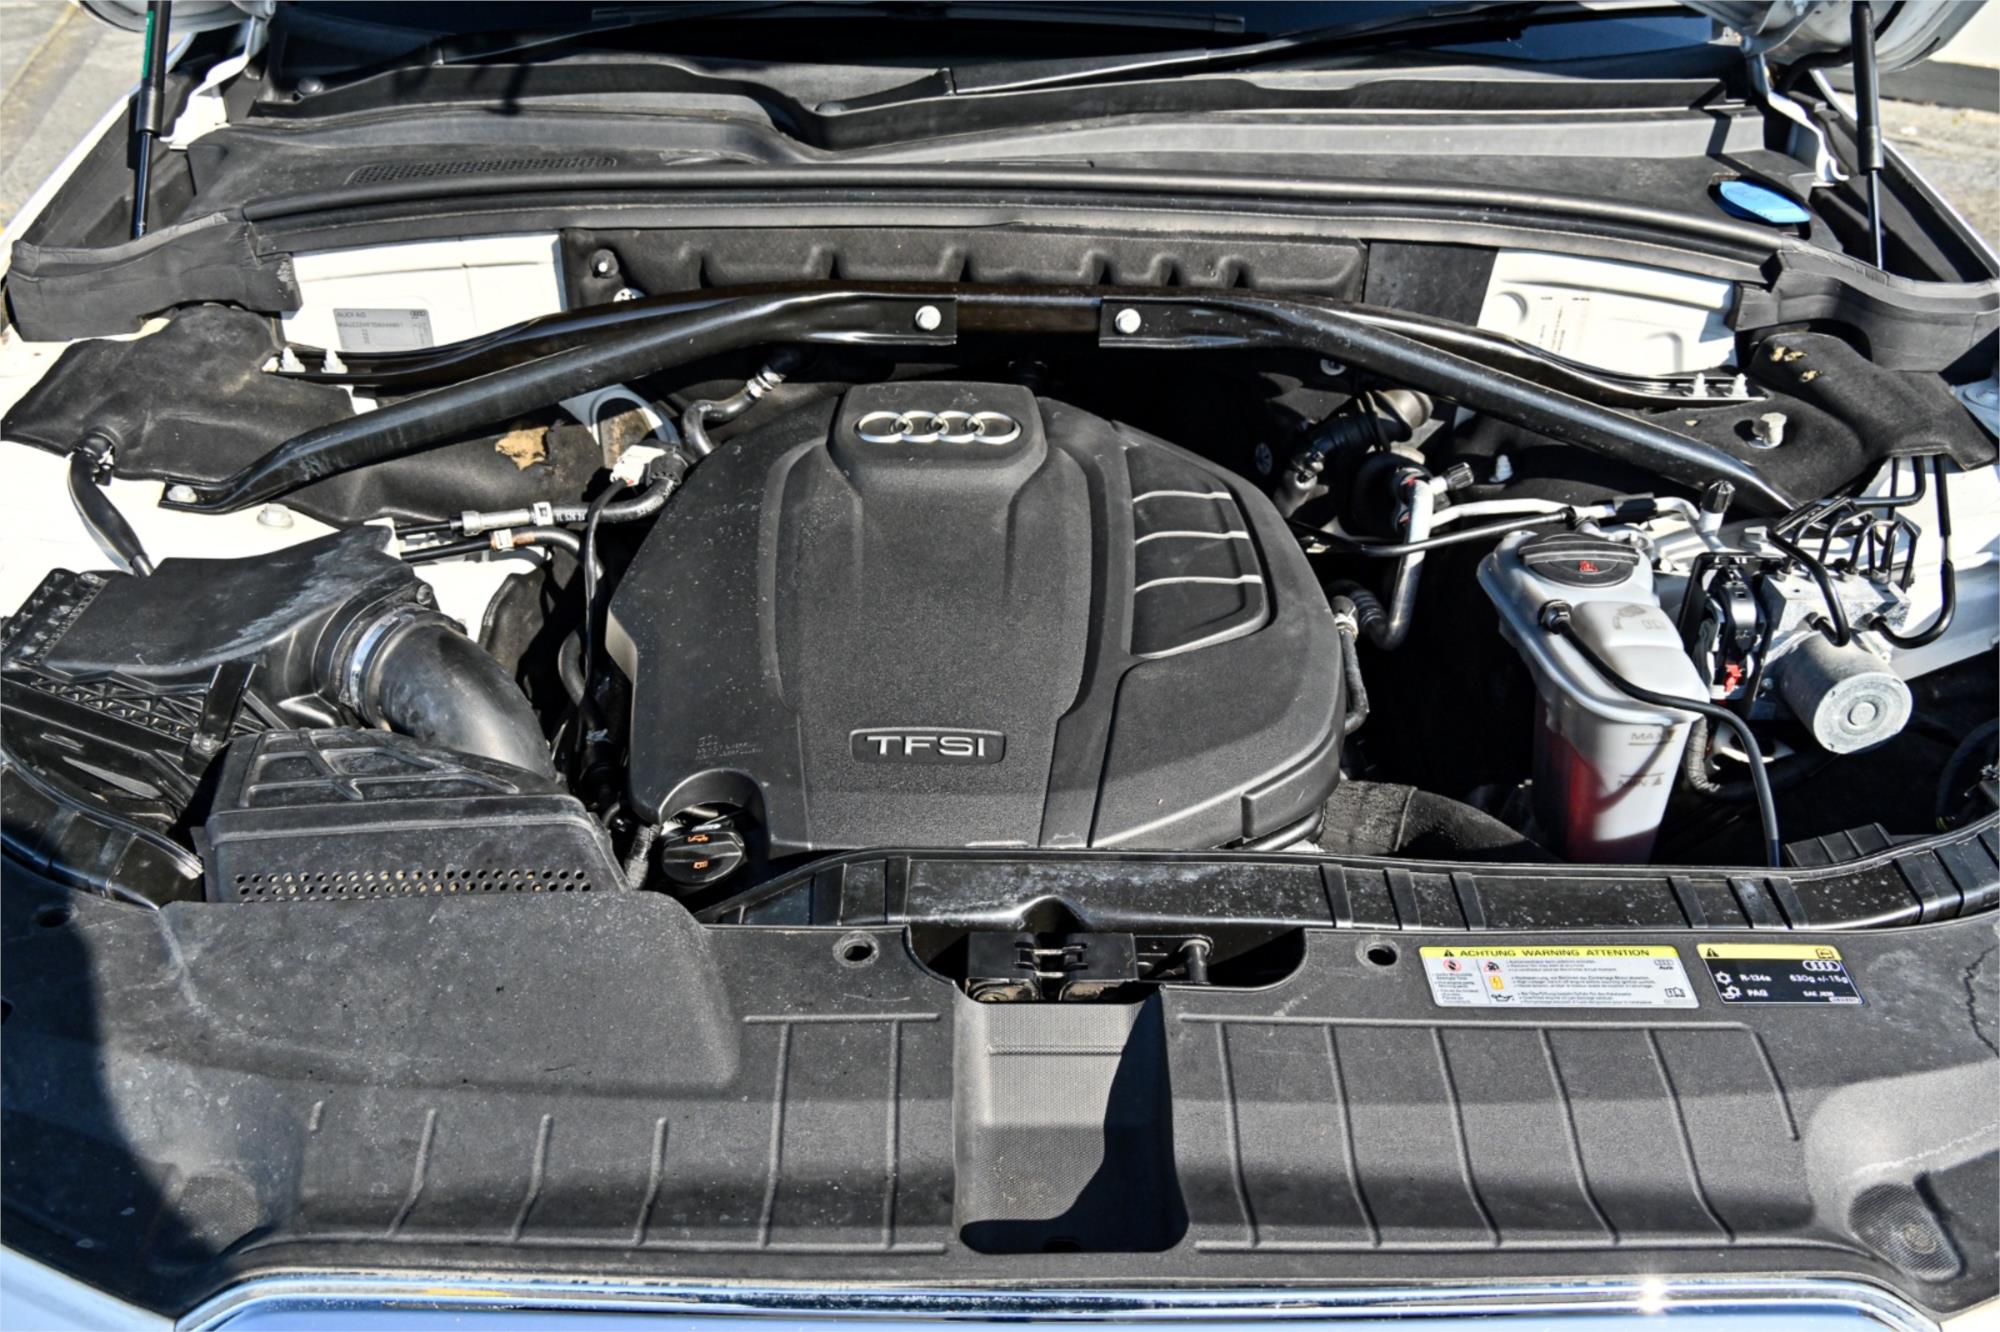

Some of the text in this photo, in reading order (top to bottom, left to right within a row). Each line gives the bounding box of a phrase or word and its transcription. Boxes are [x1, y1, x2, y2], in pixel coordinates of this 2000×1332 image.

[866, 735, 985, 757] TFSI
[1521, 949, 1580, 957] WARNING
[1586, 949, 1650, 957] ATTENTION
